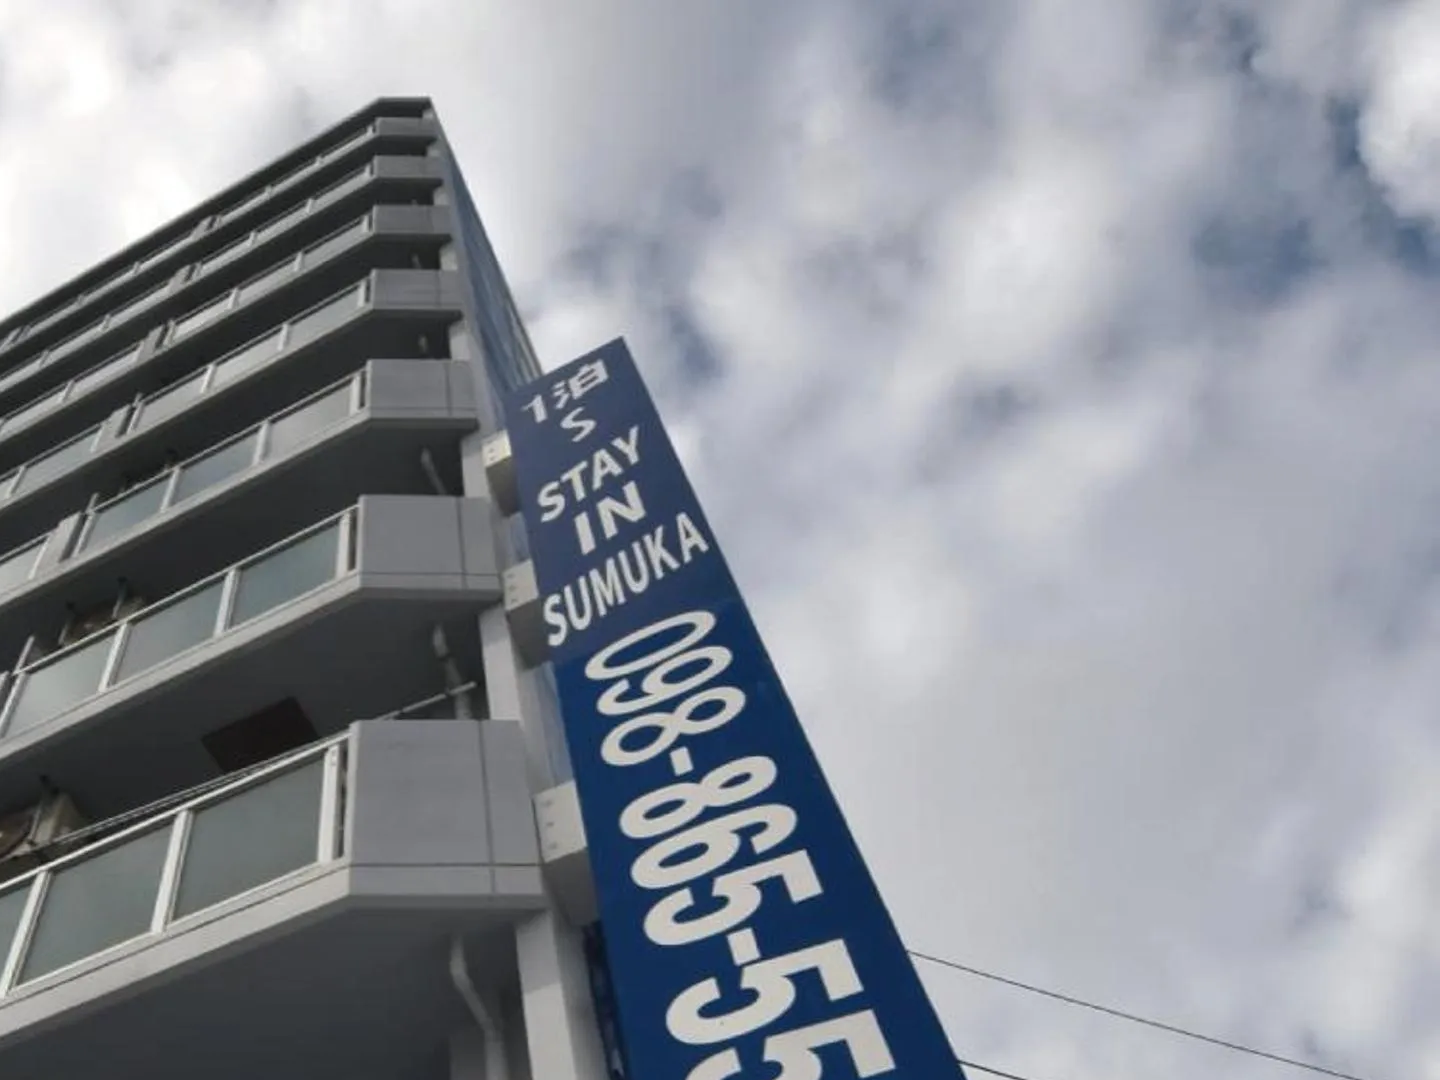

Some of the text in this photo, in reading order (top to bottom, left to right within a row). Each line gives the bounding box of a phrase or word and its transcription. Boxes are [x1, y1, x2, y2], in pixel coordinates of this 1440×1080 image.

[561, 406, 596, 442] S
[537, 426, 639, 523] STAY
[574, 480, 646, 554] IN
[543, 512, 709, 646] SUMUKA
